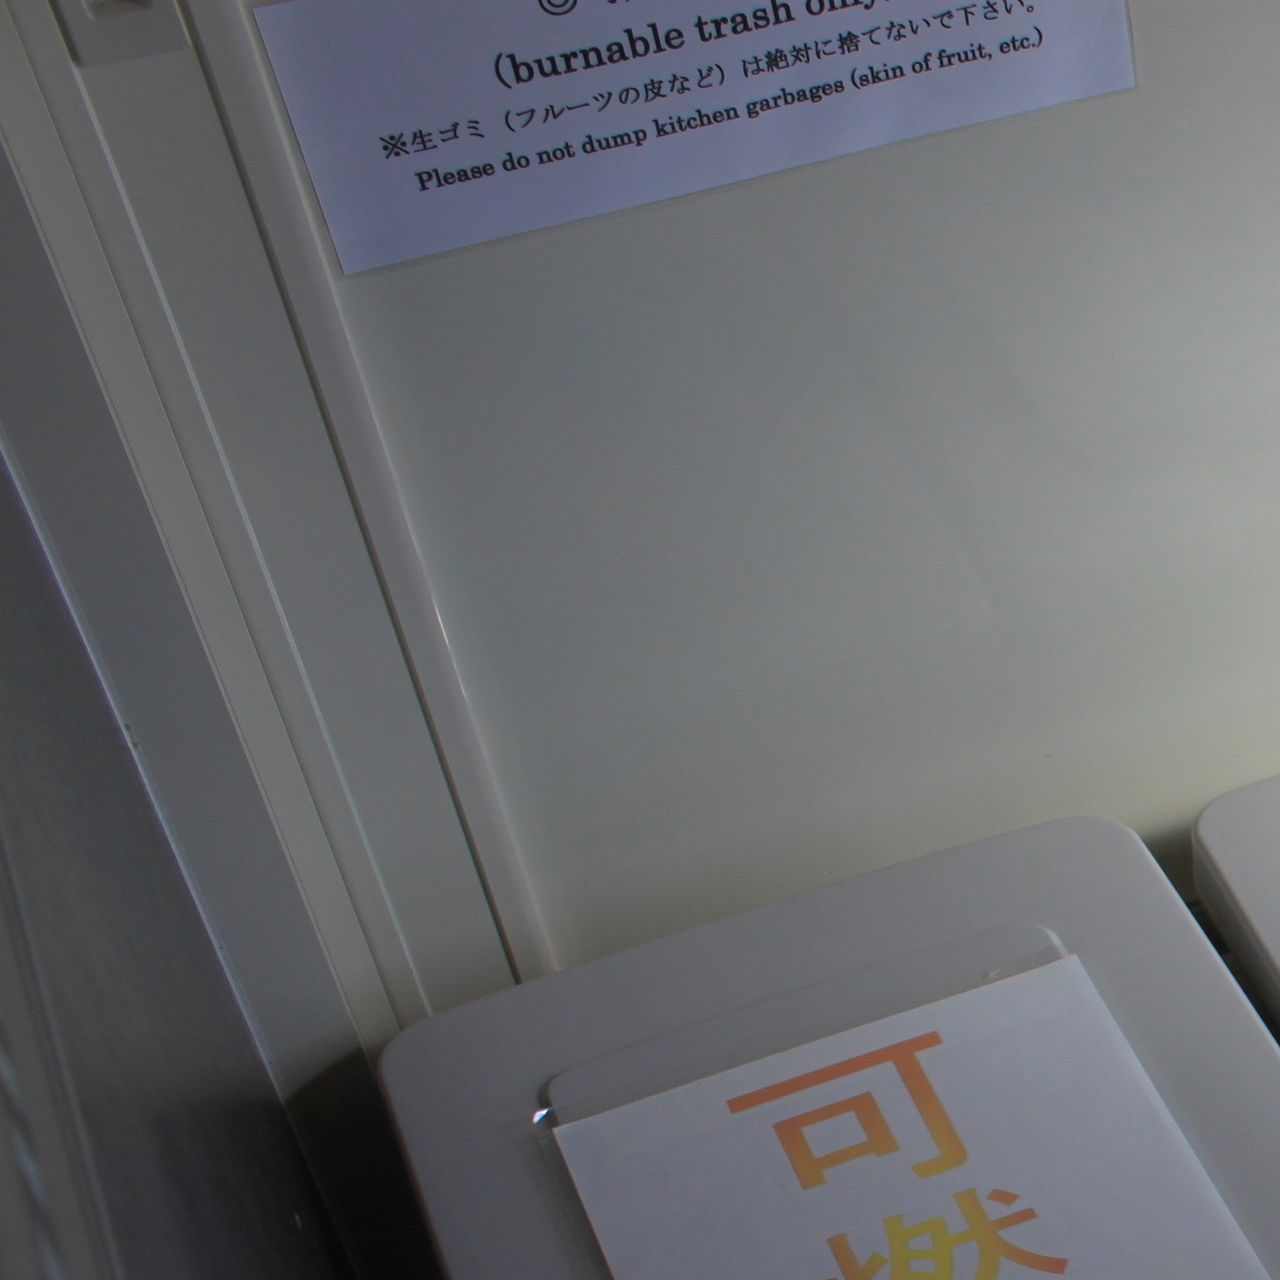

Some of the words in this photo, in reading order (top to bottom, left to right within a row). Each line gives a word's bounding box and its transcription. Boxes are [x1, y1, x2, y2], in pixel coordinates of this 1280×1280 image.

[494, 22, 686, 89] (burnable
[694, 0, 796, 43] trash
[415, 162, 496, 192] Please
[502, 151, 531, 172] do
[538, 141, 576, 165] not
[582, 129, 647, 155] dump
[654, 103, 740, 138] kitchen
[746, 78, 845, 119] garbages
[850, 62, 906, 91] (skin
[911, 52, 934, 75] of
[936, 43, 993, 69] fruit,
[999, 26, 1044, 54] etc.)
